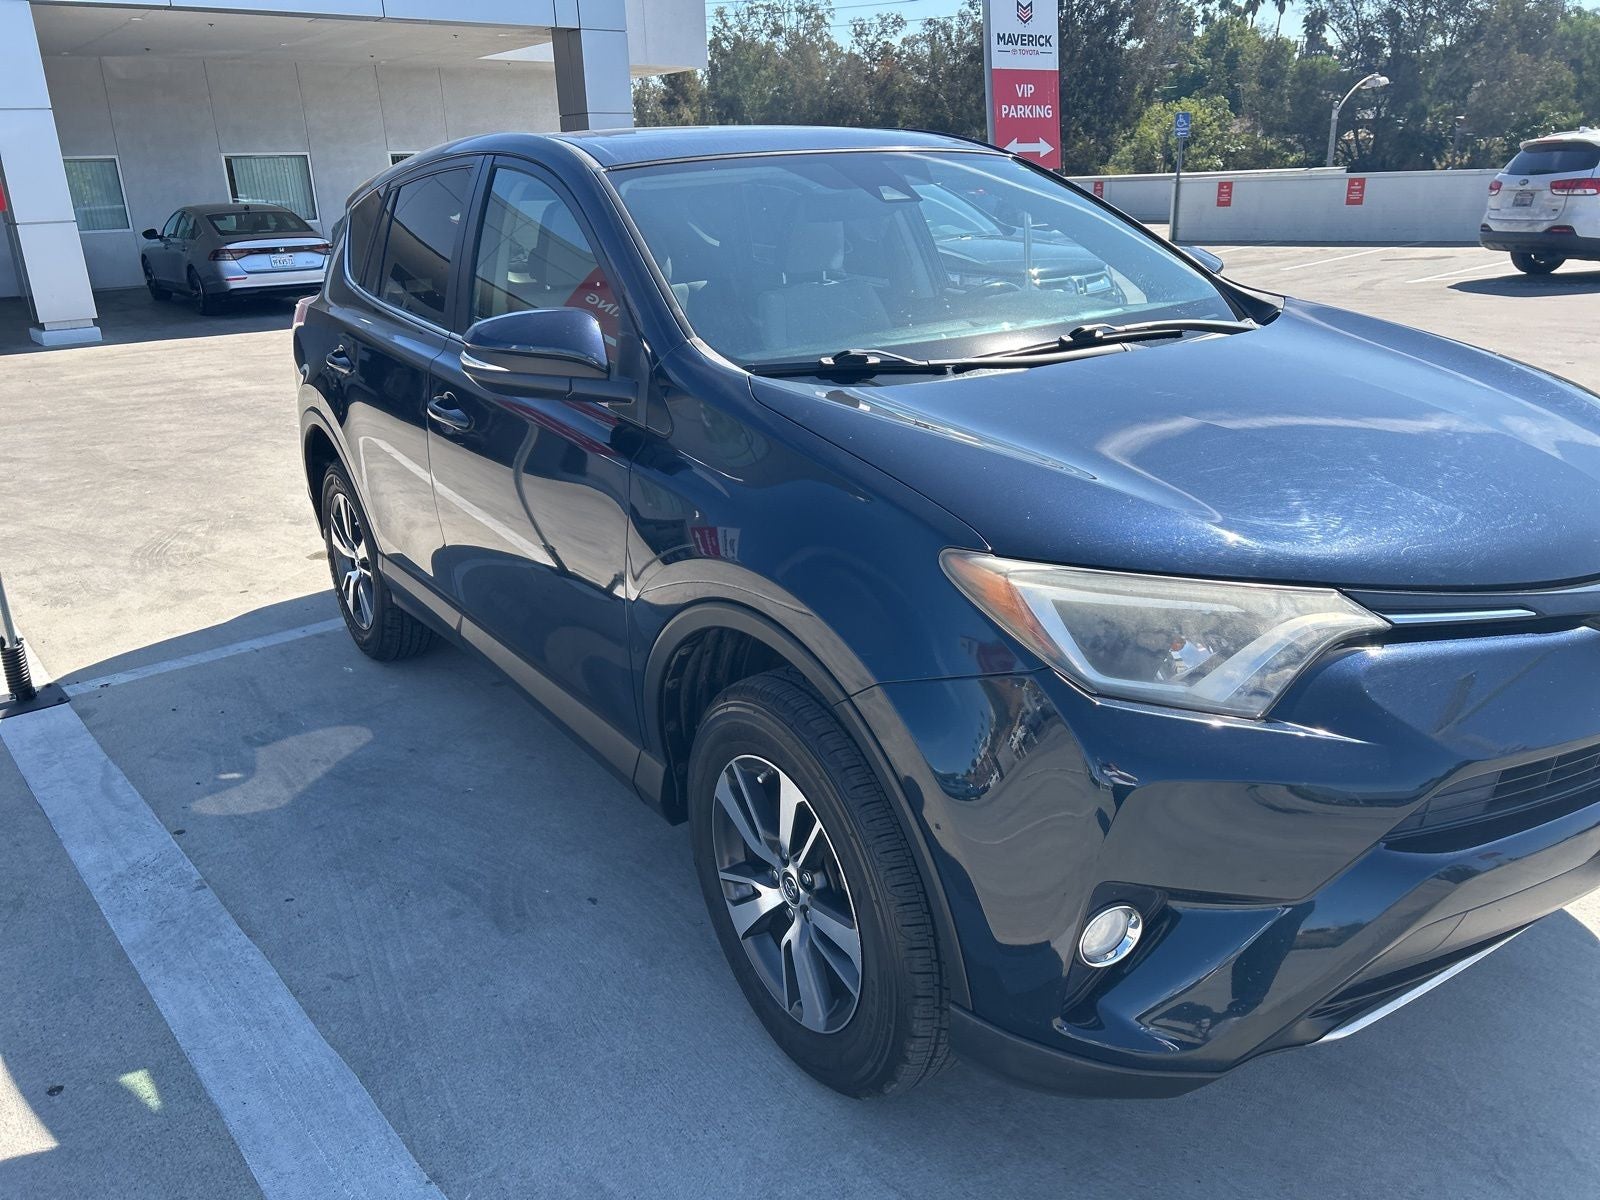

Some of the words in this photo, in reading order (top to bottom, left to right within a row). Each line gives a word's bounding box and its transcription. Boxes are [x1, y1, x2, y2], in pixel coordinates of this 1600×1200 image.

[997, 33, 1053, 47] MAVERICK
[1015, 84, 1035, 97] VIP
[1002, 105, 1053, 118] PARKING
